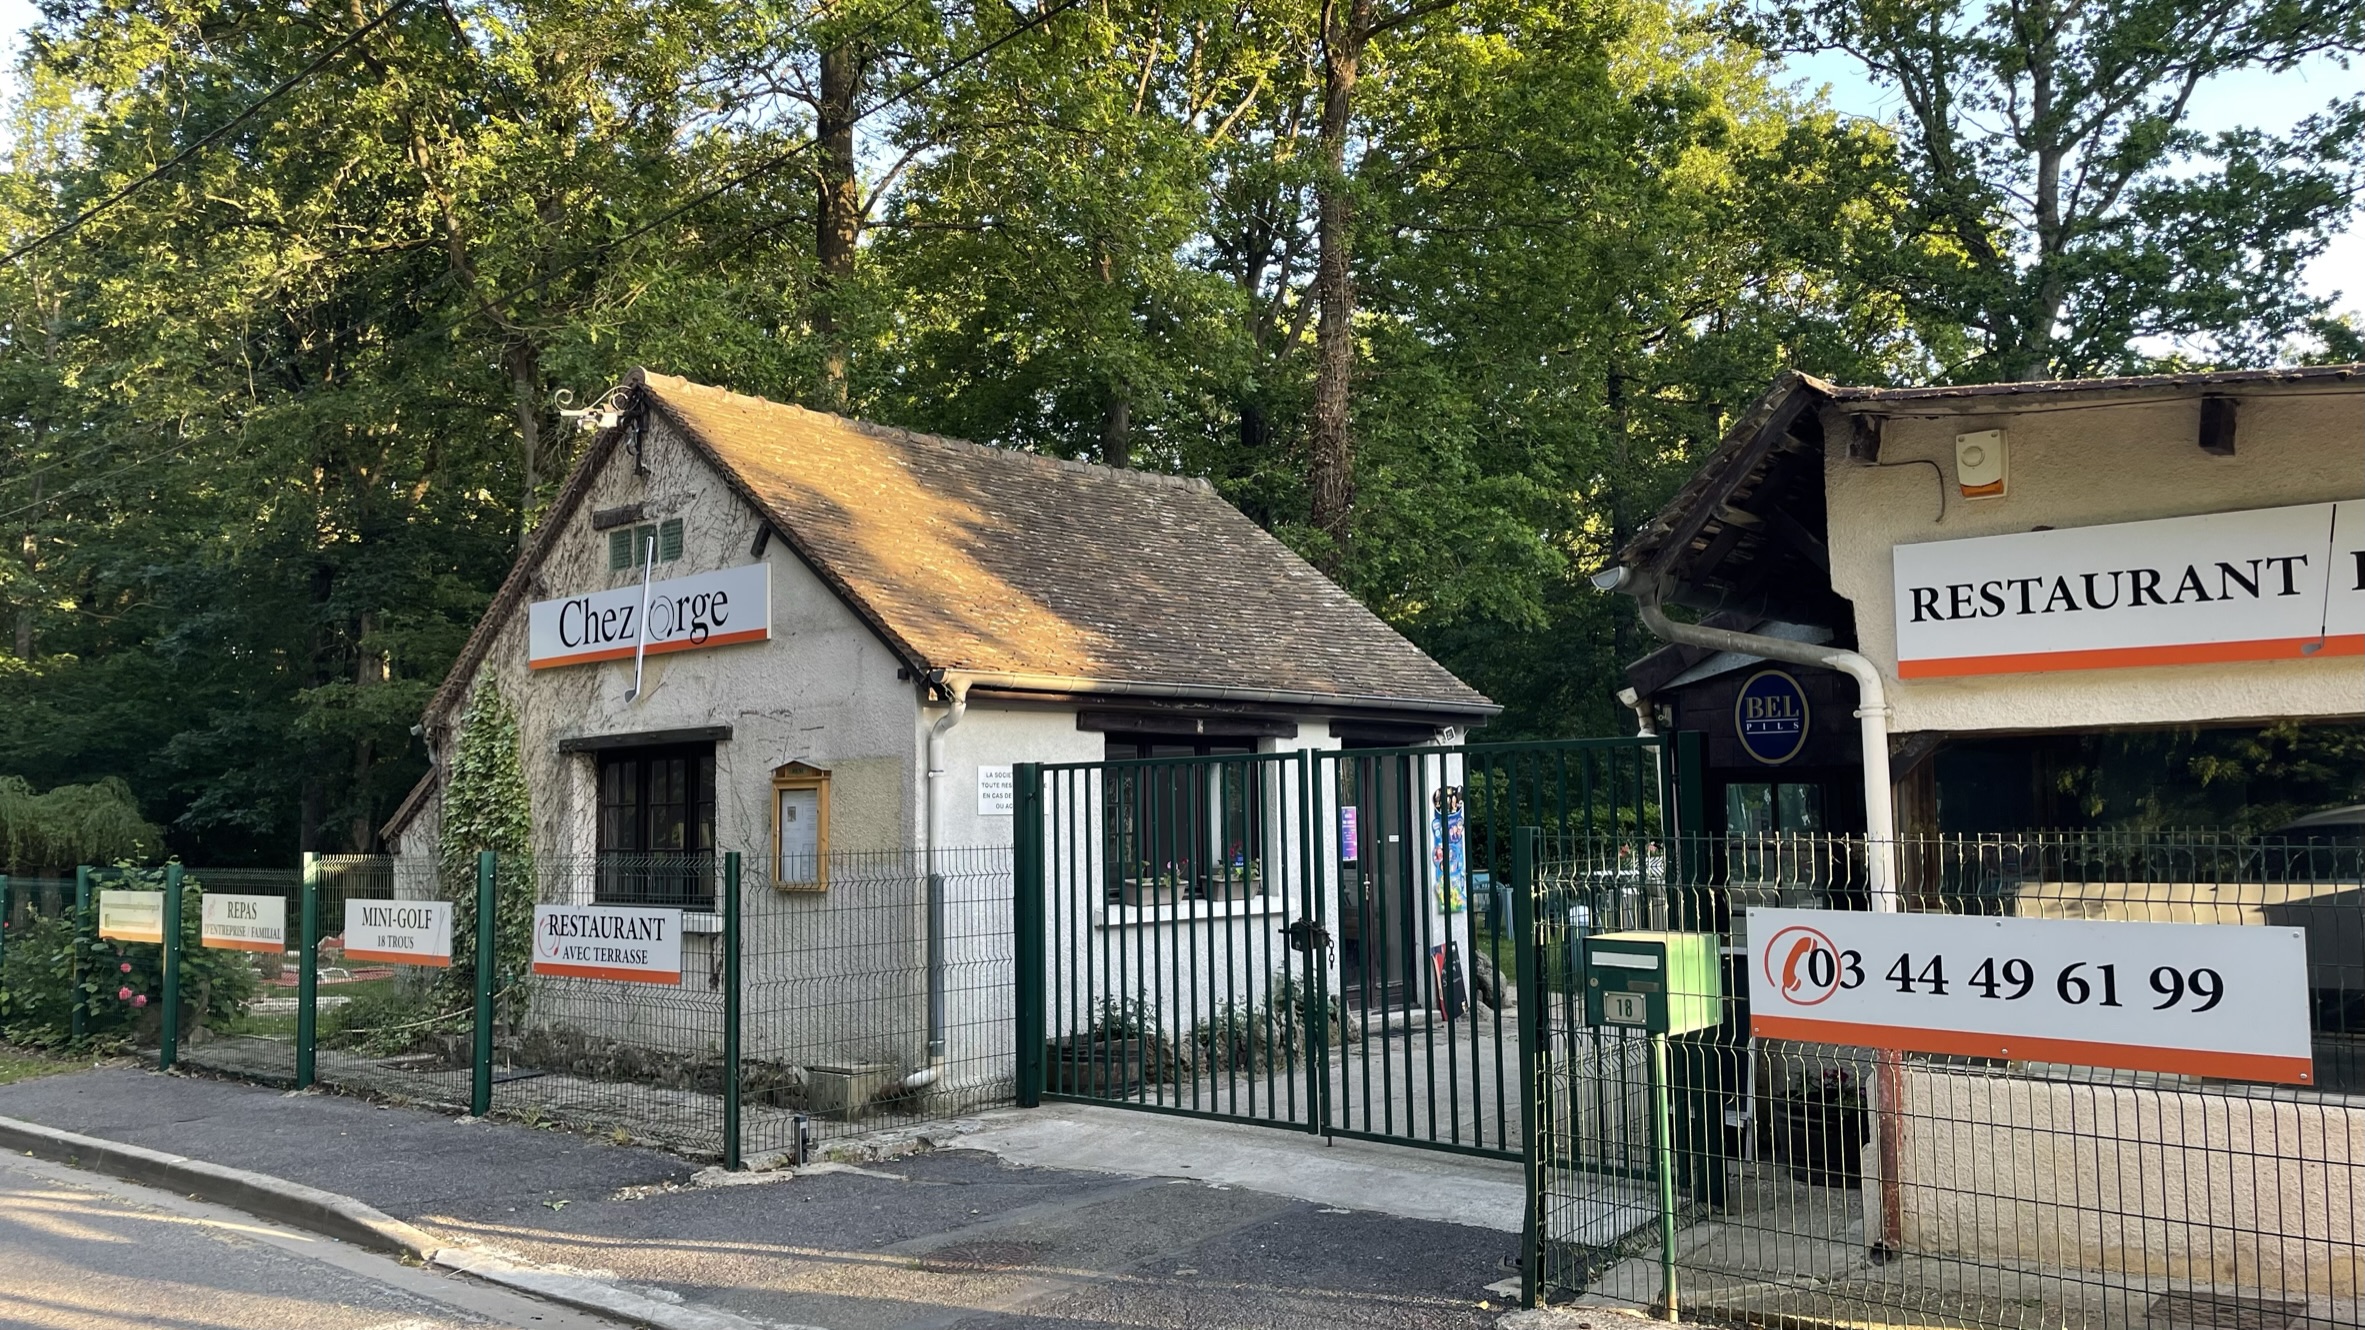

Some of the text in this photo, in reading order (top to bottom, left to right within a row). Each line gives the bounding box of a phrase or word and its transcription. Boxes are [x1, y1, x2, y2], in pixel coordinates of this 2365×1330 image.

[1908, 553, 2309, 623] RESTAURANT
[559, 598, 634, 648] Chez
[1745, 695, 1800, 719] BEL
[1746, 721, 1799, 732] PILS
[227, 901, 258, 921] REPAS
[361, 906, 433, 930] MINI-GOLF
[203, 922, 246, 937] D'ENTREPRISE
[250, 925, 282, 940] FAMILIAL
[548, 913, 666, 942] RESTAURANT
[377, 935, 415, 950] 18 TROUS
[562, 945, 649, 965] AVEC TERRASSE
[1807, 947, 2225, 1014] 03 44 49 61 99
[1616, 998, 1633, 1018] 18
